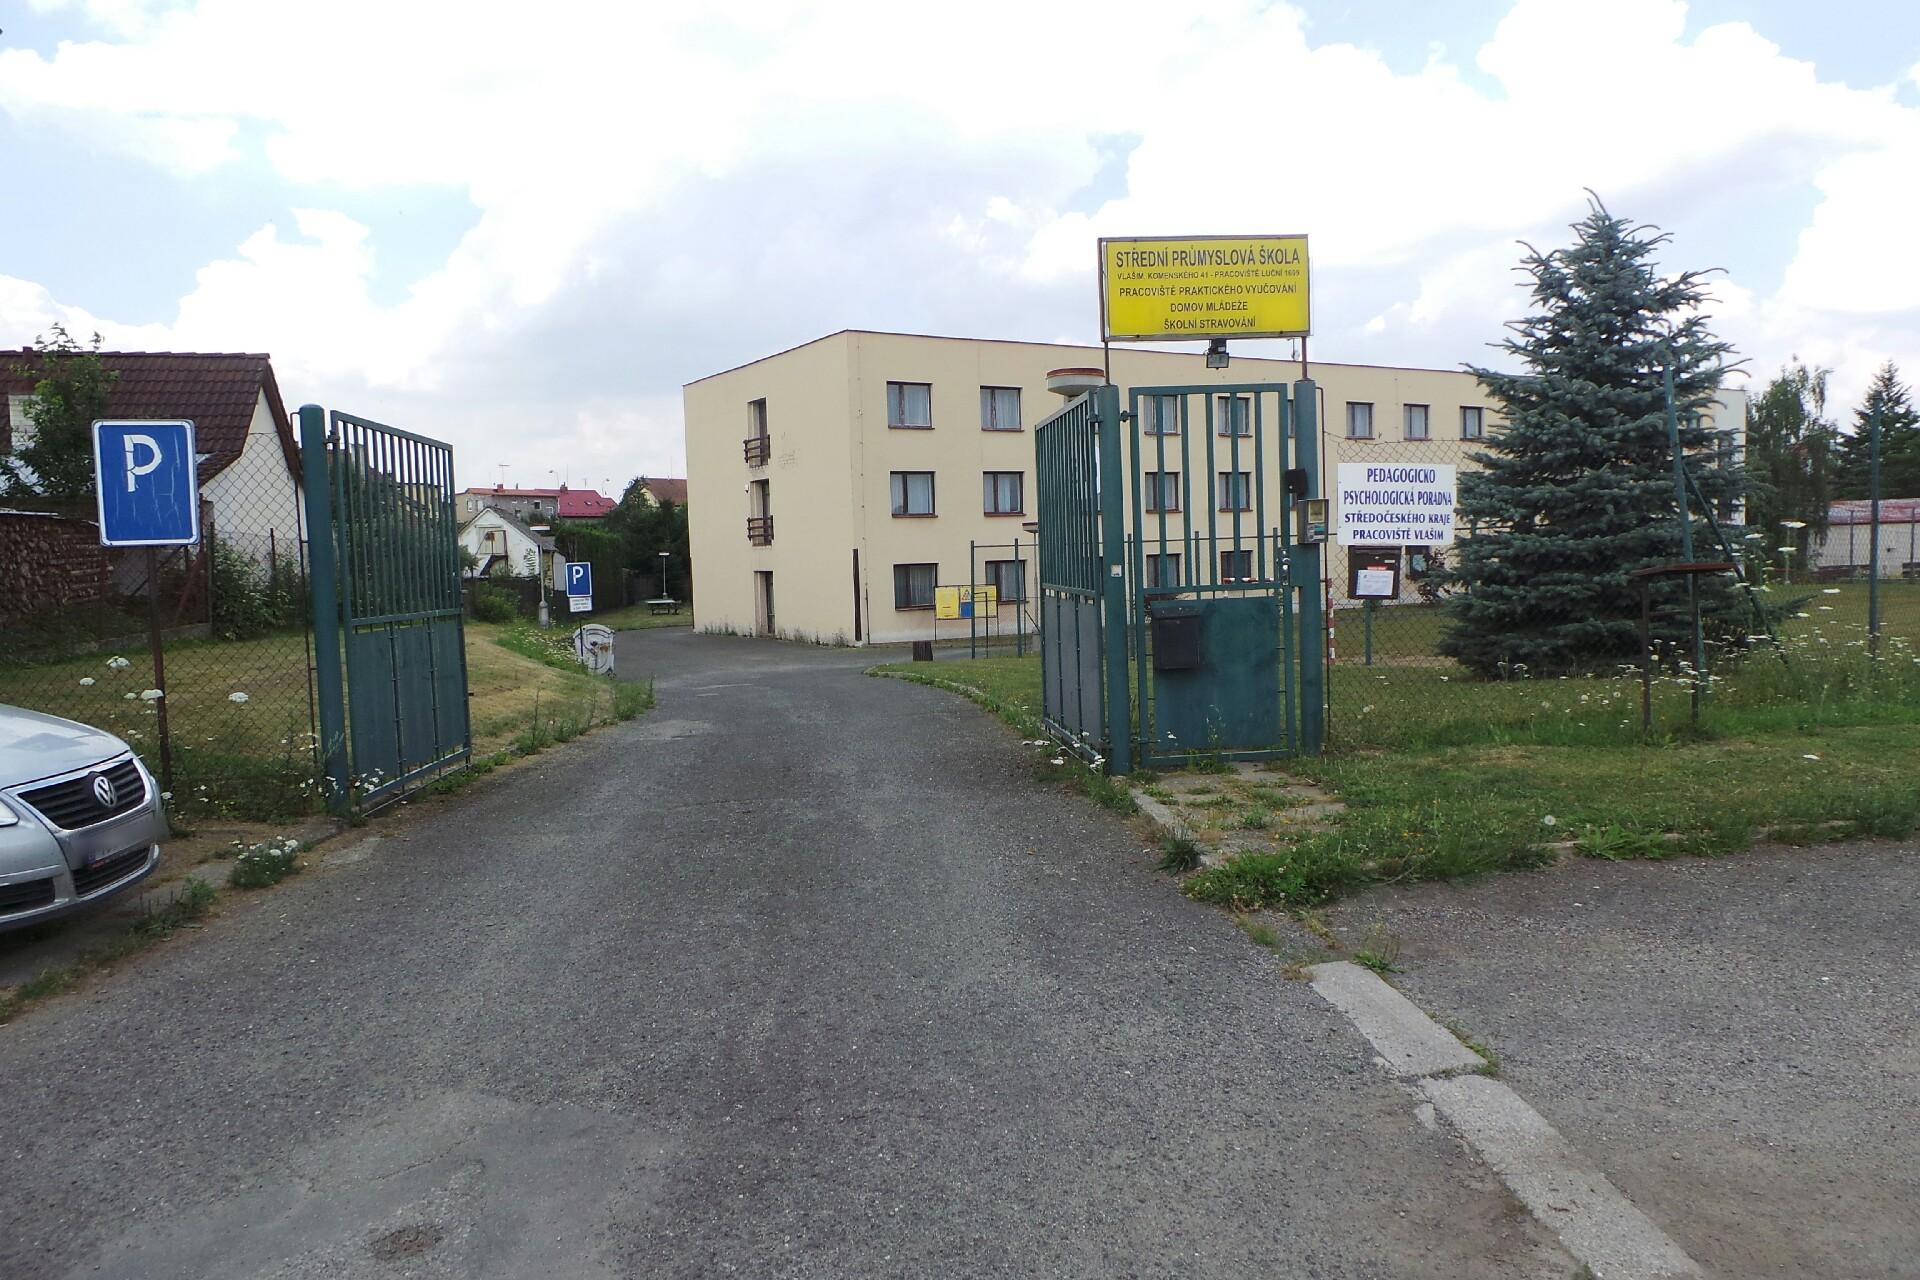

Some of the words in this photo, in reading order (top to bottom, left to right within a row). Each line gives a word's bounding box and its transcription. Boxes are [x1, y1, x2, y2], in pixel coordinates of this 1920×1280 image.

[1116, 246, 1168, 268] STŘEDNÍ
[1260, 245, 1300, 265] ŠKOLA
[1215, 268, 1260, 278] PRACOVIŠTĚ
[1262, 268, 1283, 277] LUČNÍ
[1120, 285, 1176, 296] PRACOVIŠTĚ
[1178, 284, 1243, 296] PRAKTICKÉHO
[1246, 282, 1296, 294] VYUČOVÁNÍ
[1170, 302, 1204, 312] DOMOV
[1206, 300, 1248, 312] MLÁDEŽE
[1164, 318, 1197, 330] ŠKOLNÍ
[1200, 316, 1256, 328] STRAVOVÁNÍ
[123, 434, 163, 493] P
[1367, 468, 1436, 484] PEDAGOGICKO
[1344, 487, 1414, 506] PSYCHOLOGICKÁ
[1418, 491, 1452, 506] PORADNA
[1344, 510, 1426, 524] STŘEDOČESKÉHO
[1428, 514, 1451, 526] KRAJE
[1352, 527, 1411, 540] PRACOVIŠTĚ
[1414, 528, 1444, 540] VLAŠIM
[572, 566, 584, 584] P
